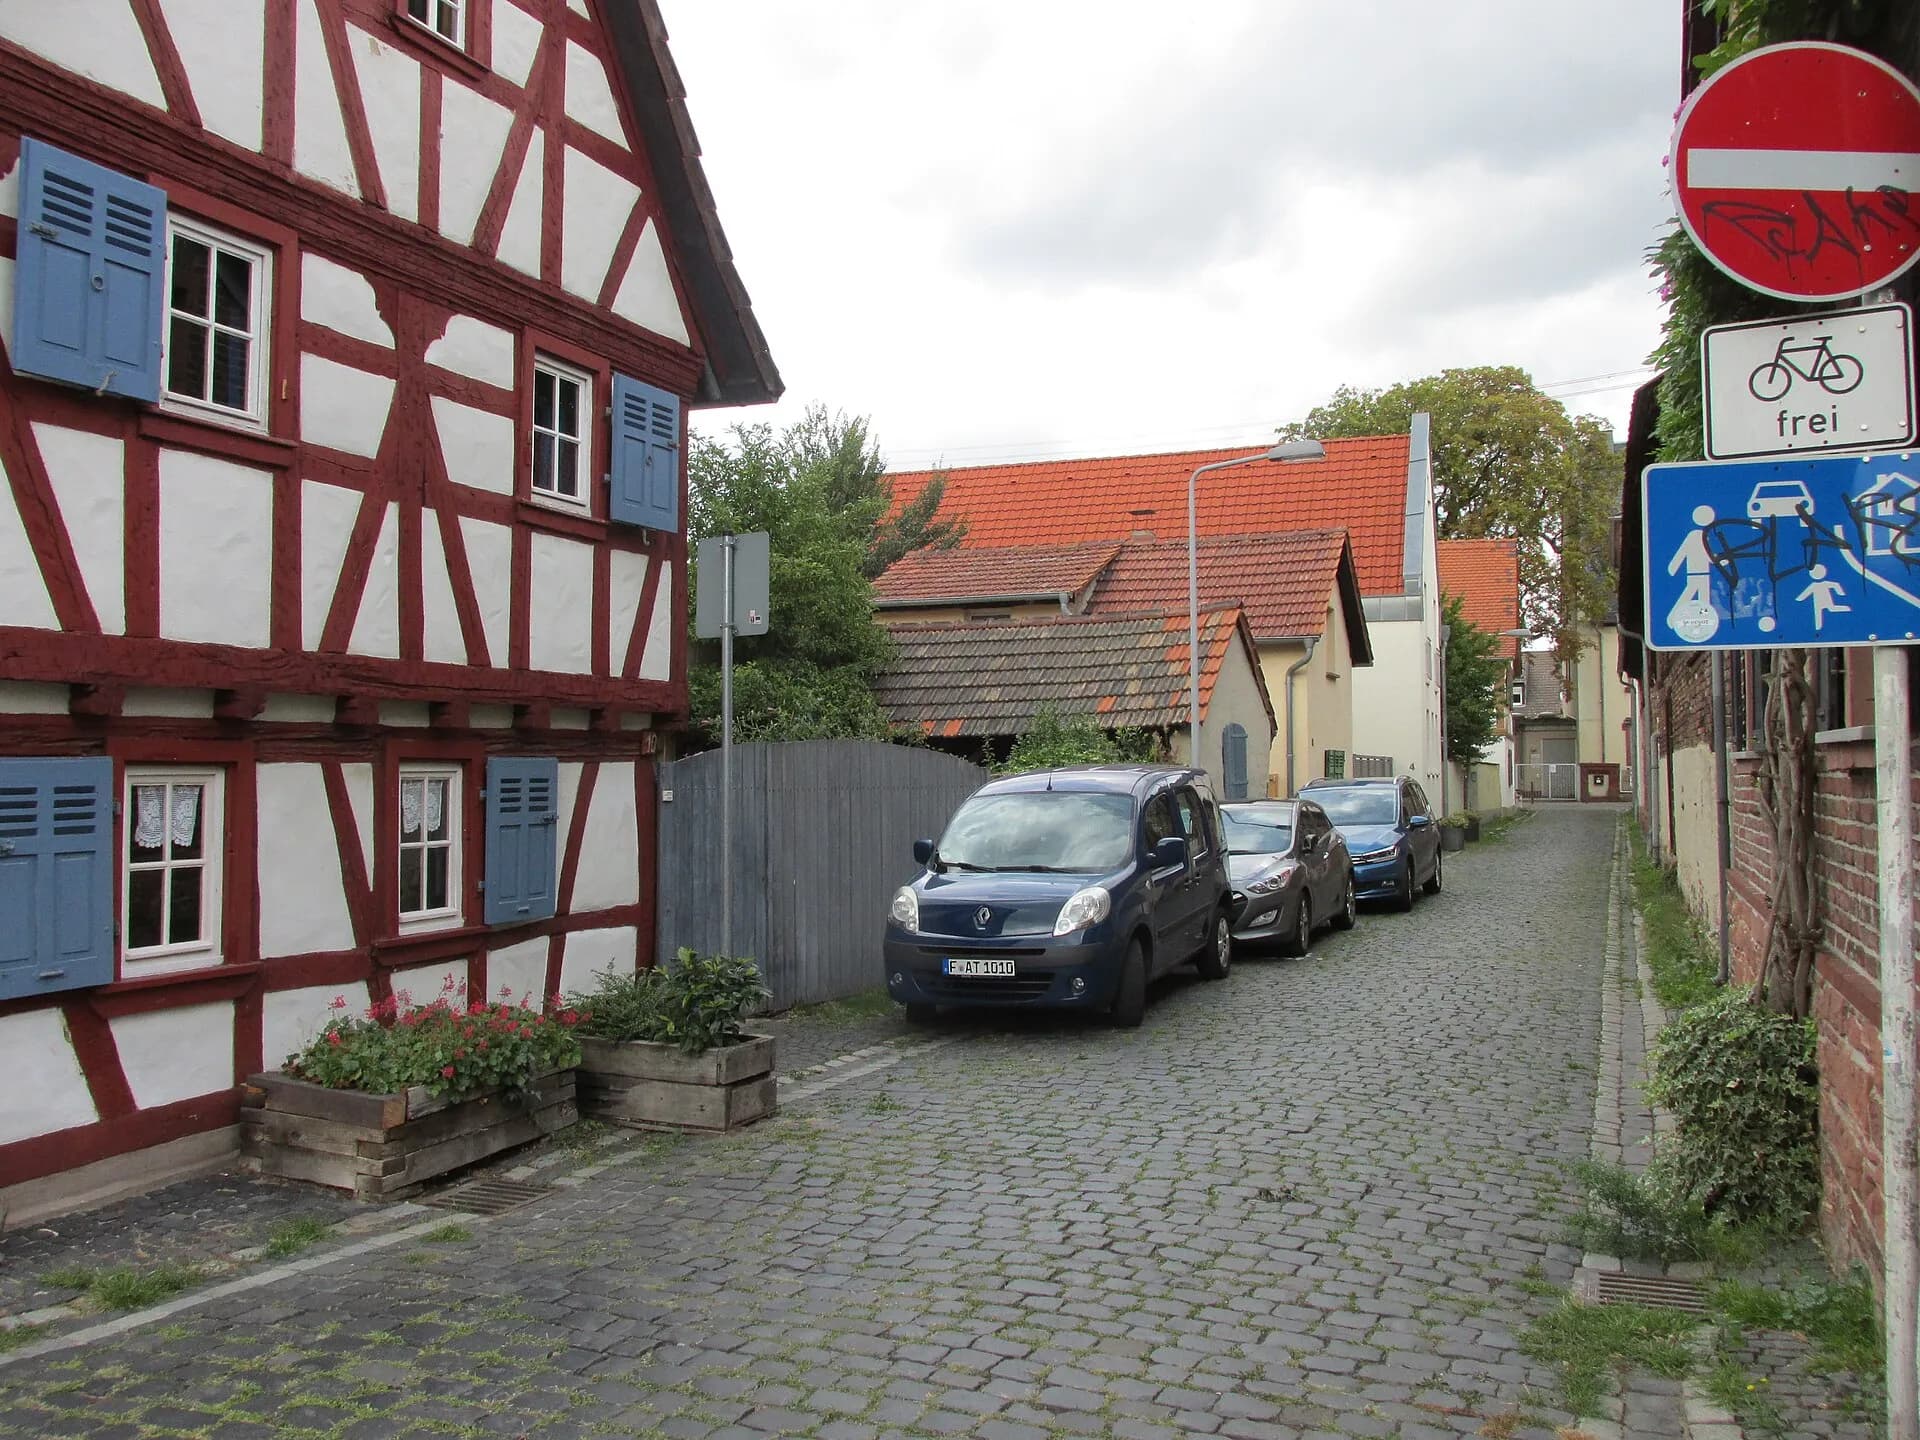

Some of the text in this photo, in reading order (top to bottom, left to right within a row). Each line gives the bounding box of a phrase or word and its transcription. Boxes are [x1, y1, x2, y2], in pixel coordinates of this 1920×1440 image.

[1777, 404, 1838, 437] frei
[949, 960, 1013, 974] F AT 1010
